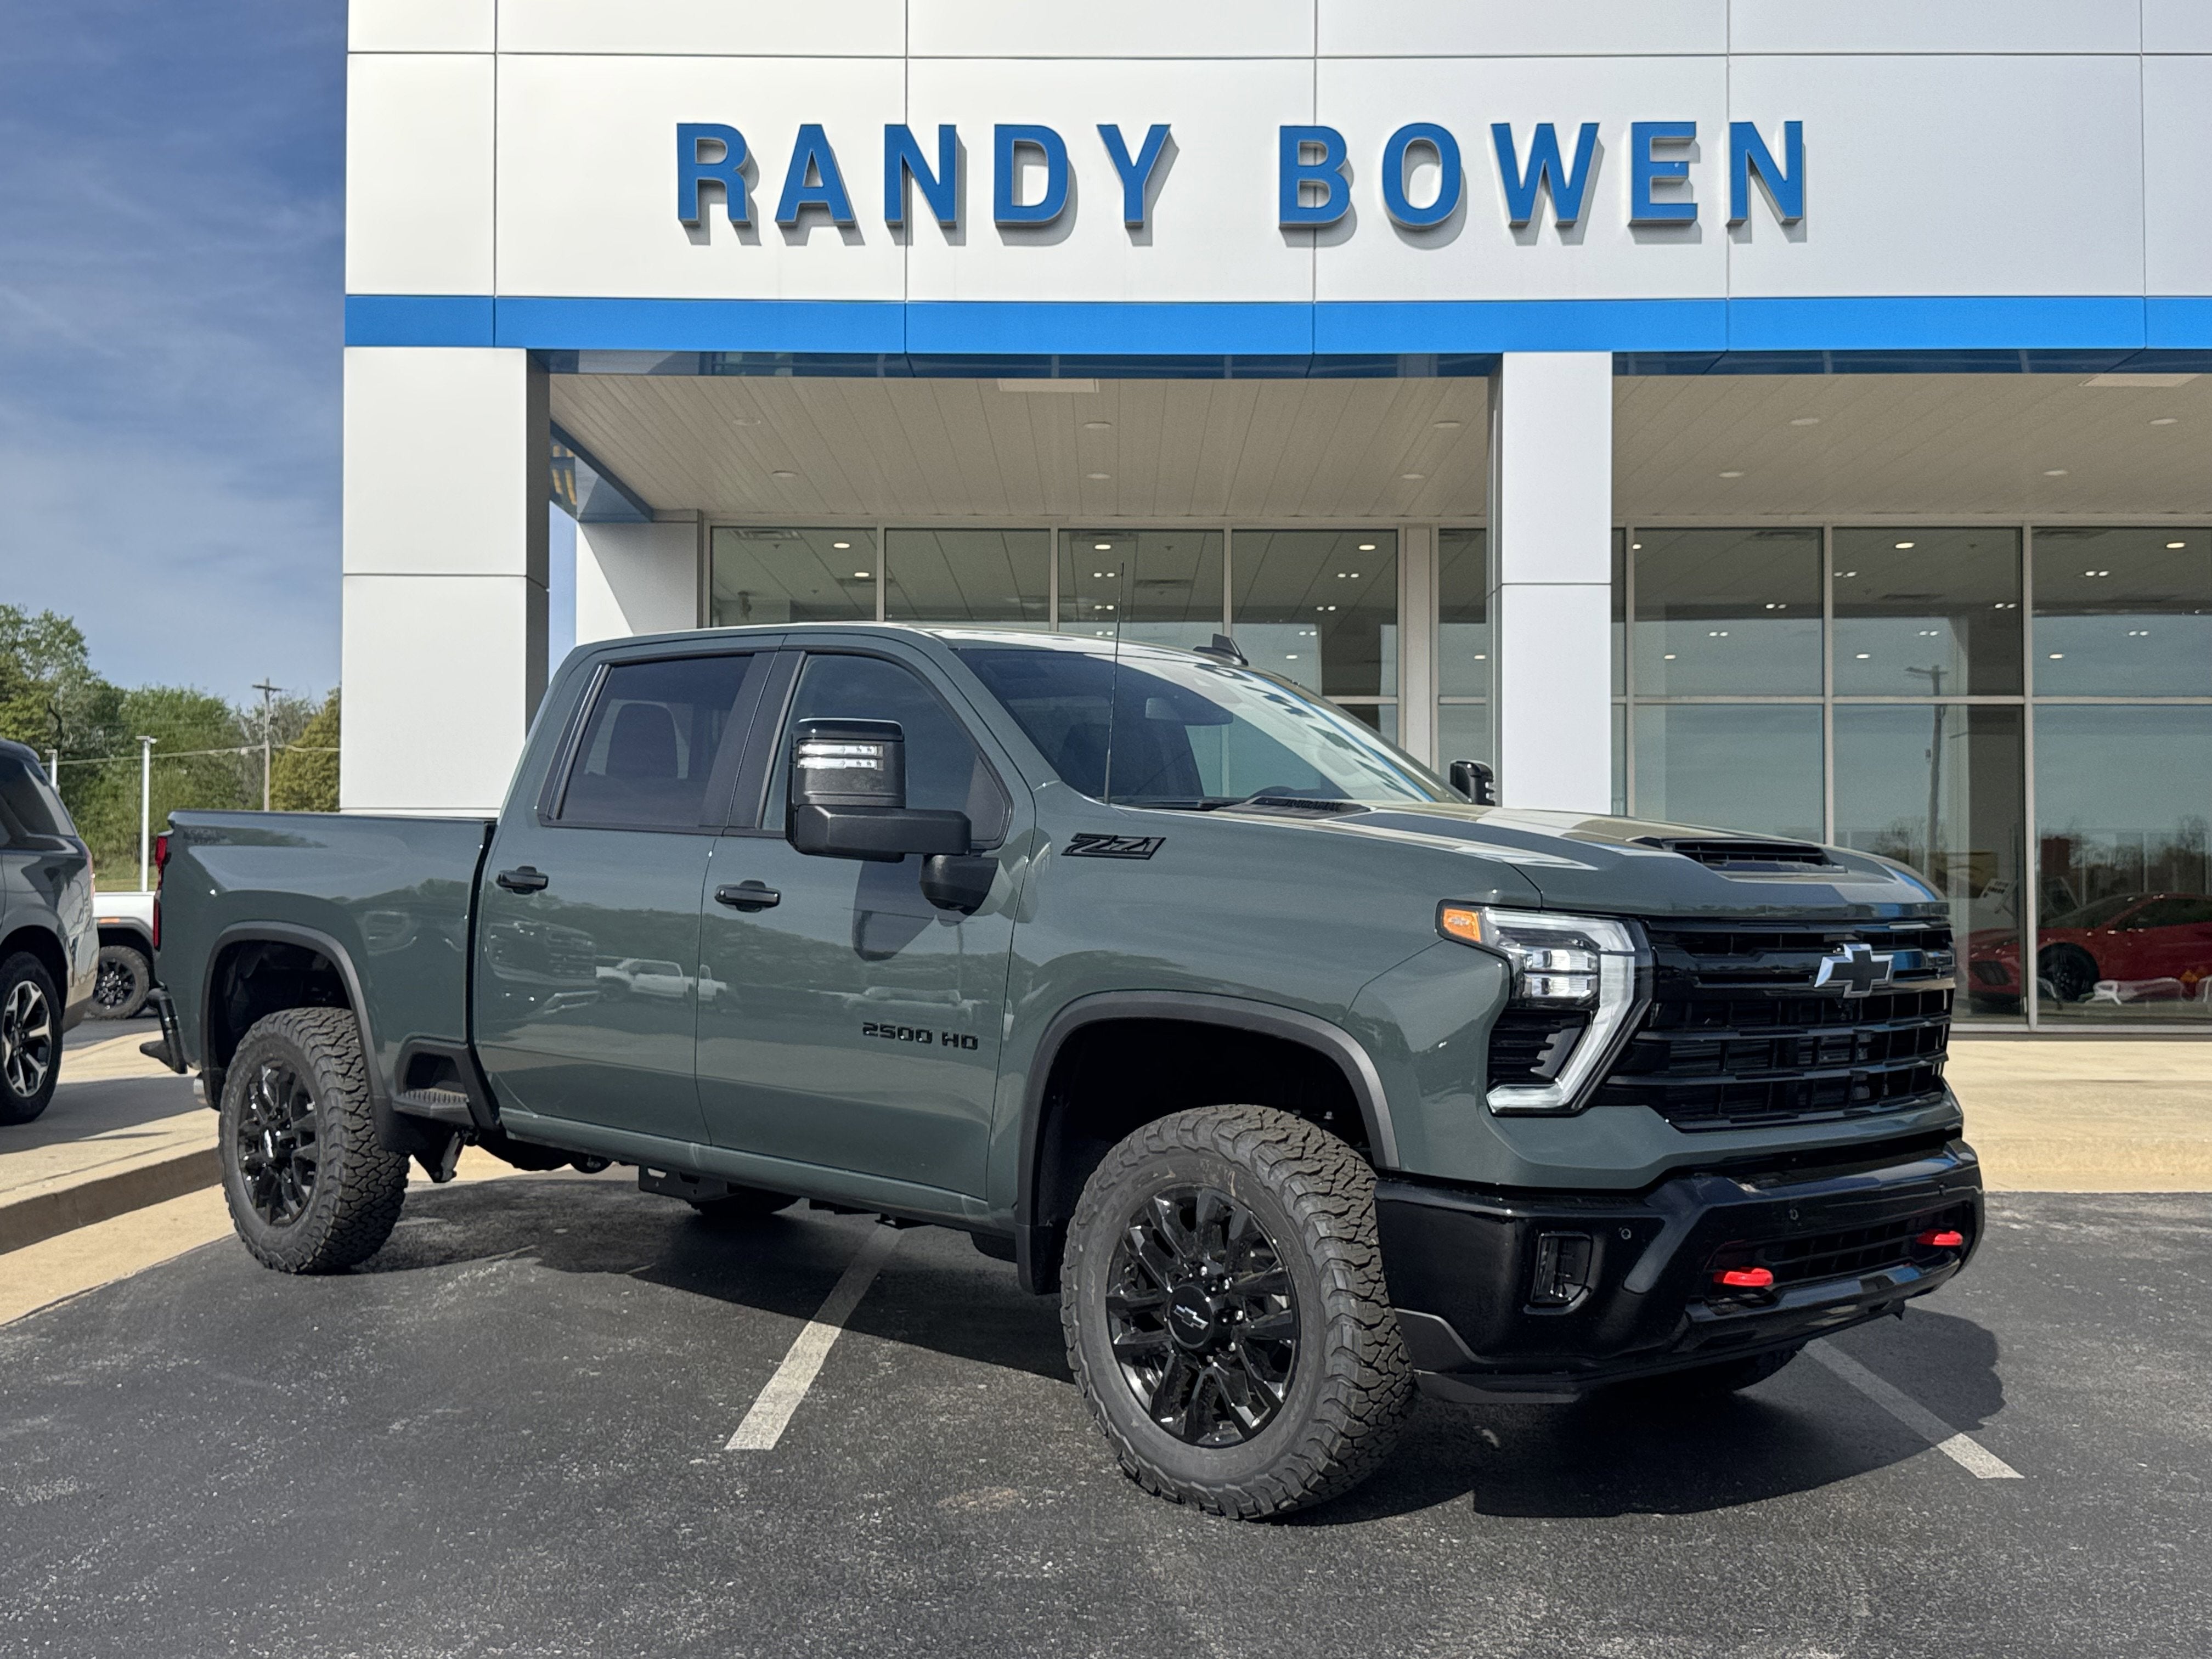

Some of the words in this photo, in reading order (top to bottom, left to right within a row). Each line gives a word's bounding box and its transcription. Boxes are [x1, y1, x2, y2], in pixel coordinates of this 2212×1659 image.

[676, 123, 1171, 227] RANDY
[1279, 120, 1803, 227] BOWEN
[1060, 832, 1166, 860] Z71
[862, 1022, 933, 1044] 2500
[942, 1031, 978, 1051] HD
